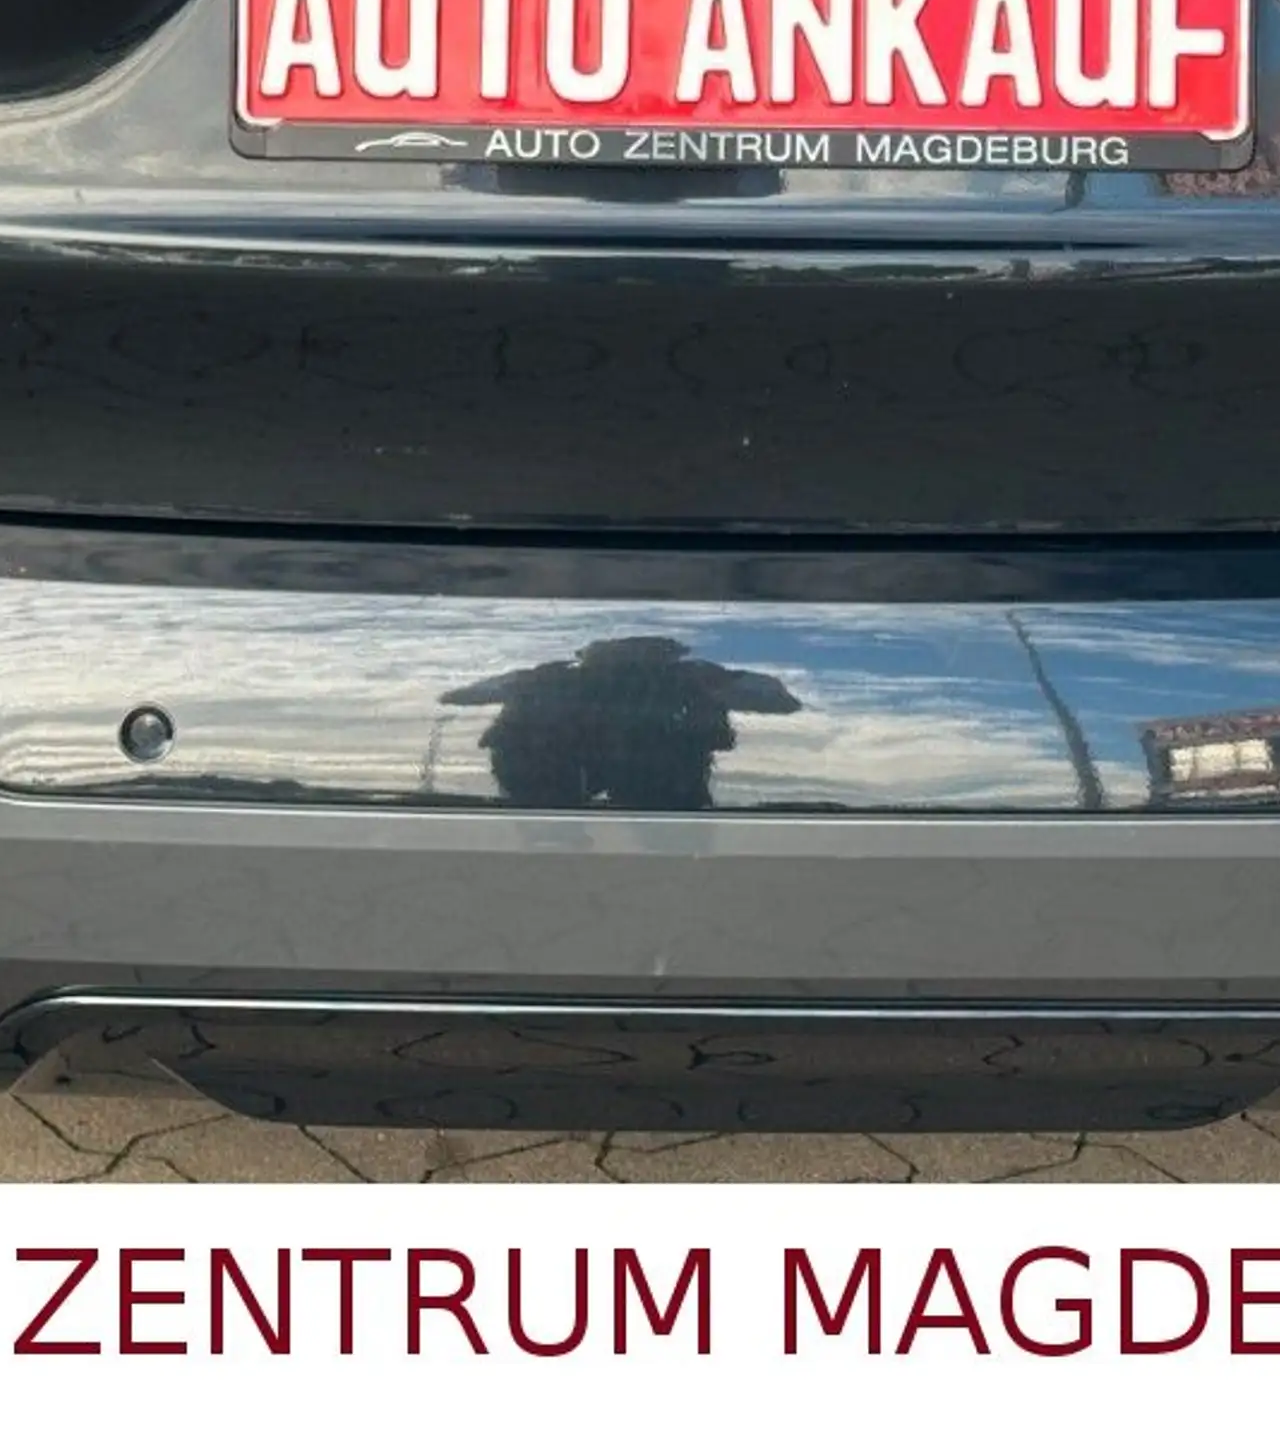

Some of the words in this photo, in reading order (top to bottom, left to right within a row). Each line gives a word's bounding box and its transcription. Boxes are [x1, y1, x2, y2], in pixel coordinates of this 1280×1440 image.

[484, 128, 600, 159] AUTO
[622, 131, 830, 162] ZENTRUM
[855, 135, 1130, 165] MAGDEBURG
